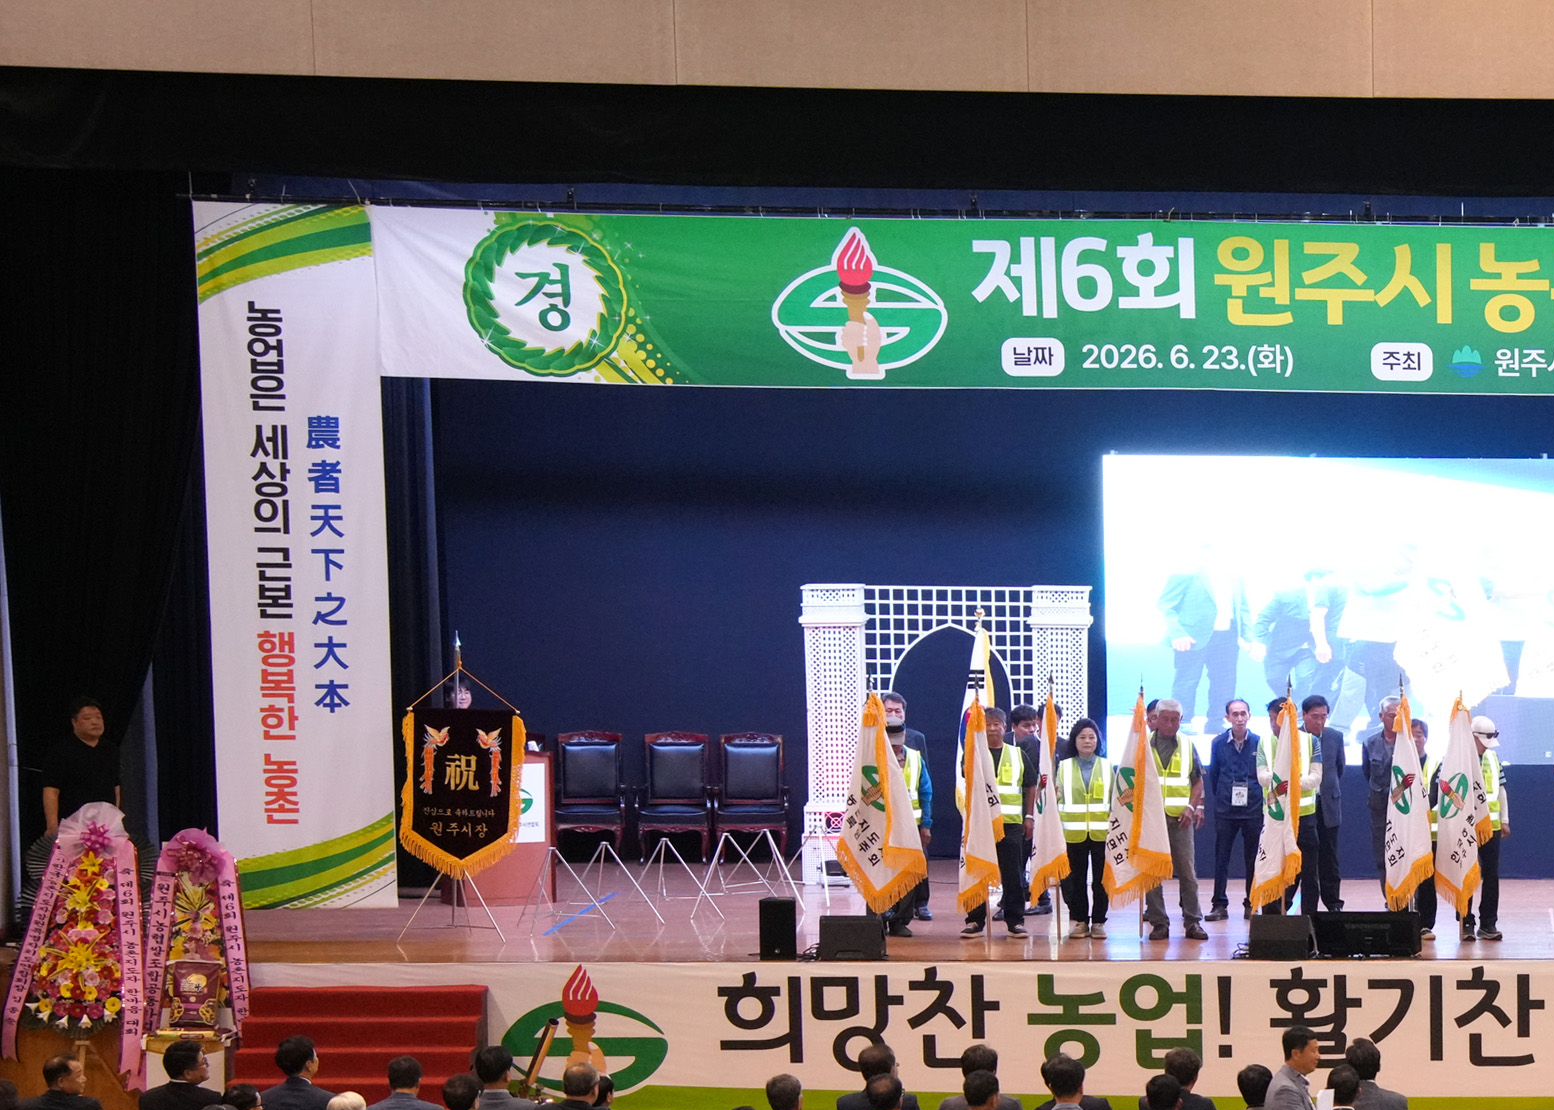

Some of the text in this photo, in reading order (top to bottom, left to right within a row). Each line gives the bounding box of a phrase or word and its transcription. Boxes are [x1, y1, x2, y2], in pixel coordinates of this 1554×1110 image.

[514, 263, 573, 332] 경
[971, 232, 1197, 320] 제6회
[1213, 235, 1453, 327] 원주시
[1012, 346, 1055, 368] 날짜
[1081, 343, 1294, 376] 2026. 6. 23.(화)
[1381, 350, 1422, 371] 주최
[246, 301, 300, 824] 농업은 세상의 근본 행복한 농촌
[306, 415, 350, 713] 農者天下之大本
[445, 753, 480, 791] 祝
[429, 821, 489, 839] 원주시장
[717, 965, 1000, 1071] 희망찬
[1027, 972, 1232, 1071] 농업!
[1269, 965, 1545, 1068] 활기찬
